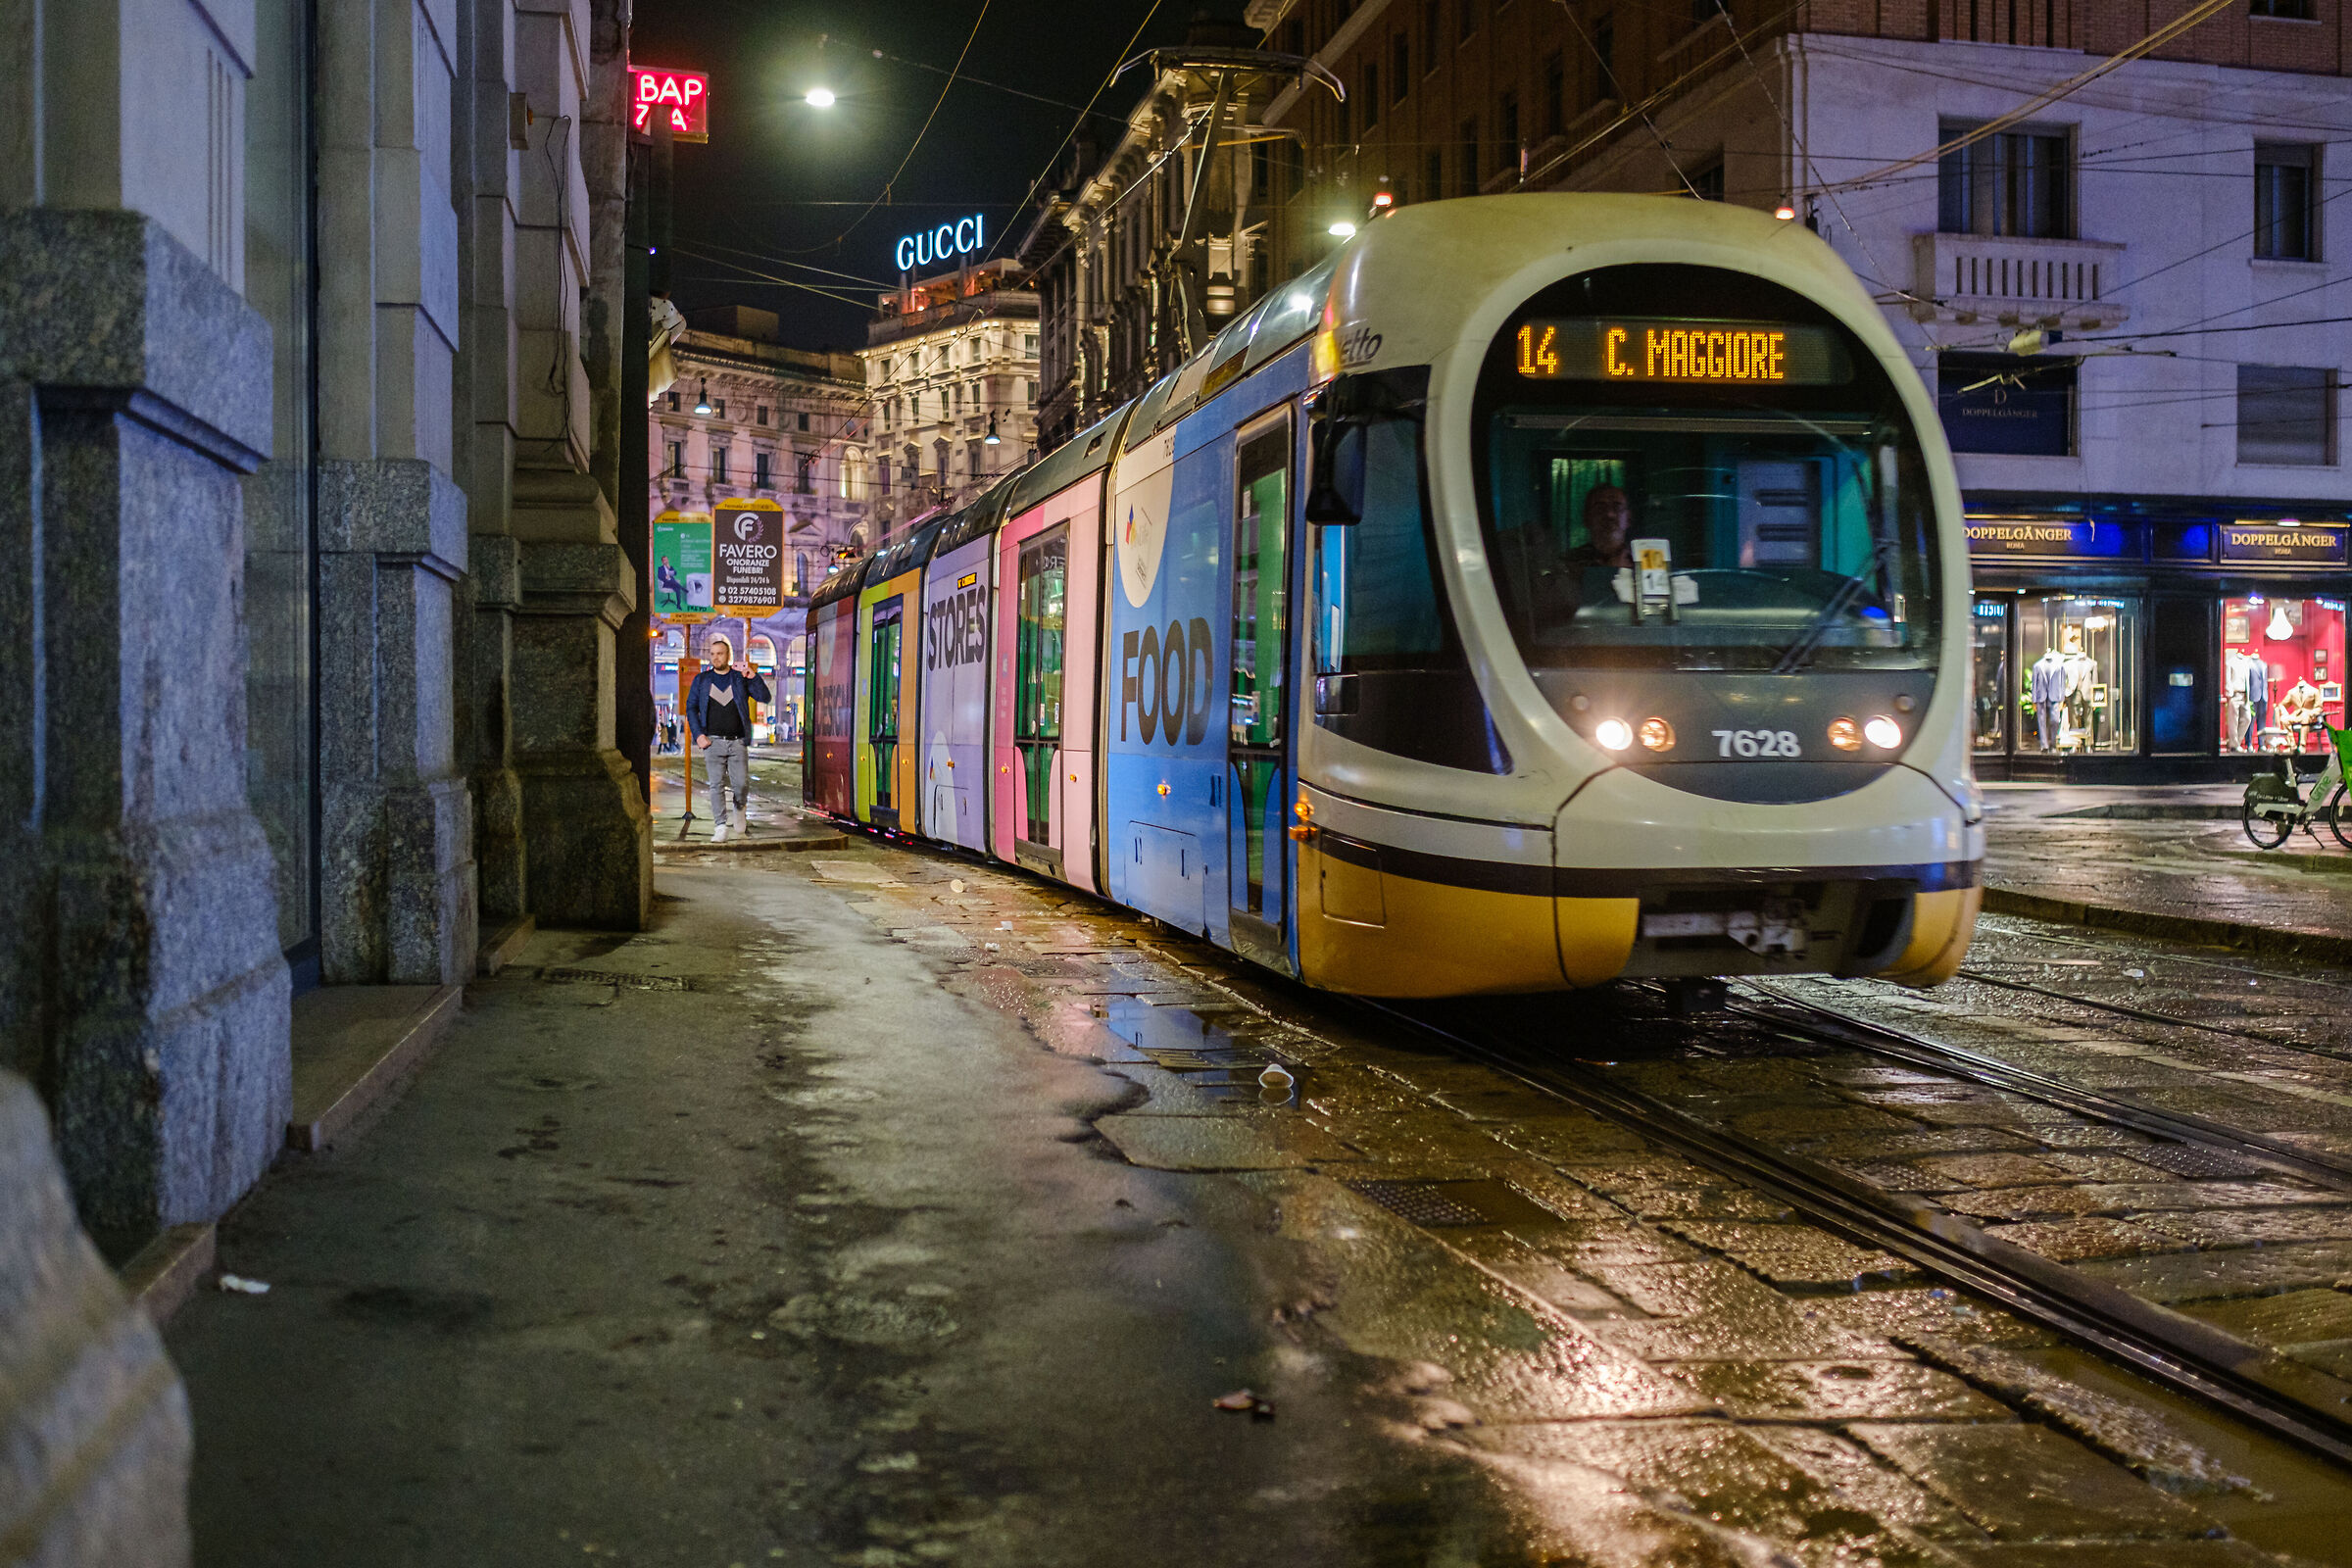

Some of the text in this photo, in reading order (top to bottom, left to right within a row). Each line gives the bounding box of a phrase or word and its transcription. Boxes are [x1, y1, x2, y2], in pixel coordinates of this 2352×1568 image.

[896, 213, 983, 271] GUCCI
[1518, 326, 1785, 379] 14 C. MAGGIORE
[1962, 526, 2073, 541] DOPPELGÄNGER
[2231, 532, 2337, 547] DOPPELGÄNGER
[719, 543, 777, 559] FAVERO
[726, 559, 769, 567] ONORANZE
[727, 586, 776, 596] 02 57405108
[728, 595, 776, 605] 3279876901
[928, 585, 987, 672] STORES
[1120, 616, 1213, 747] FOOD
[1711, 729, 1802, 758] 7628
